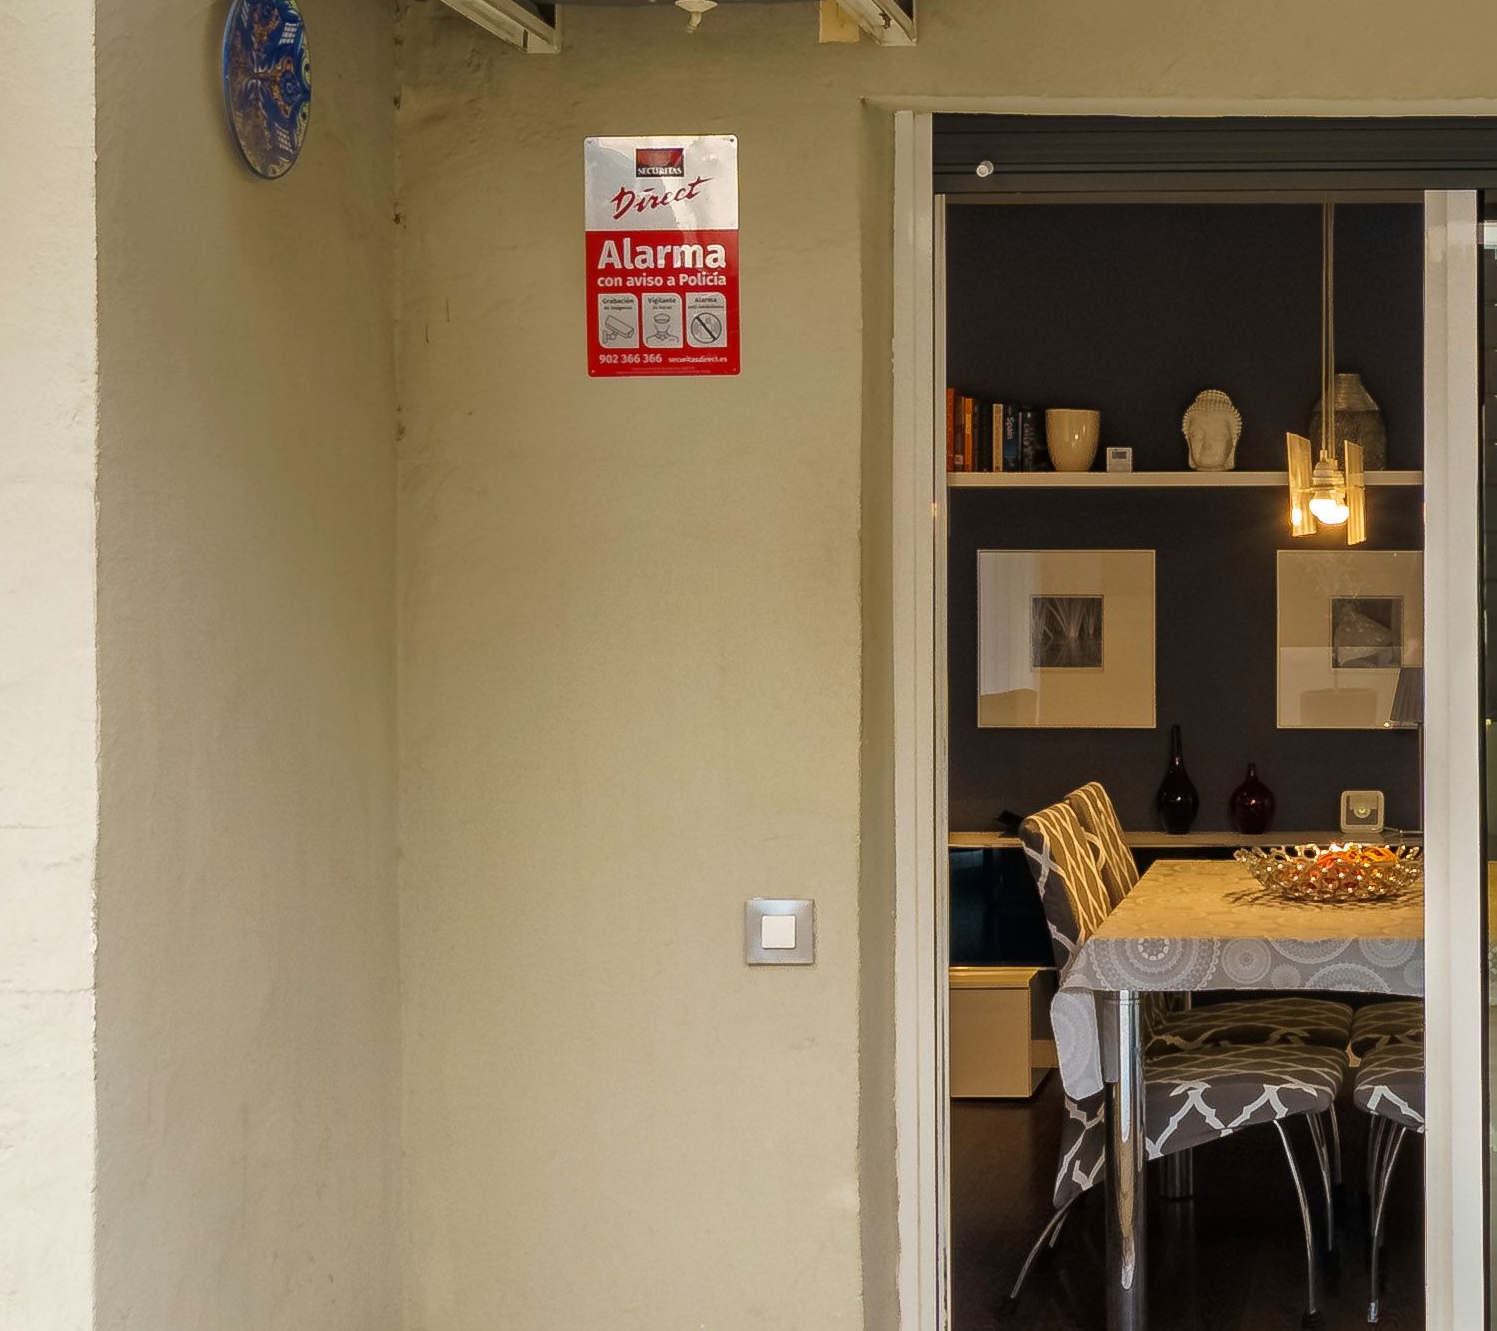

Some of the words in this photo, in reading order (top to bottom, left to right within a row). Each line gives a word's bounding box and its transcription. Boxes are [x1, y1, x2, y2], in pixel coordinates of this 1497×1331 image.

[597, 237, 726, 269] Alarma
[597, 276, 622, 287] con
[626, 273, 663, 287] aviso
[666, 276, 675, 286] a
[679, 271, 727, 286] Policía
[599, 354, 618, 364] 902
[621, 354, 640, 364] 366
[643, 353, 663, 363] 366
